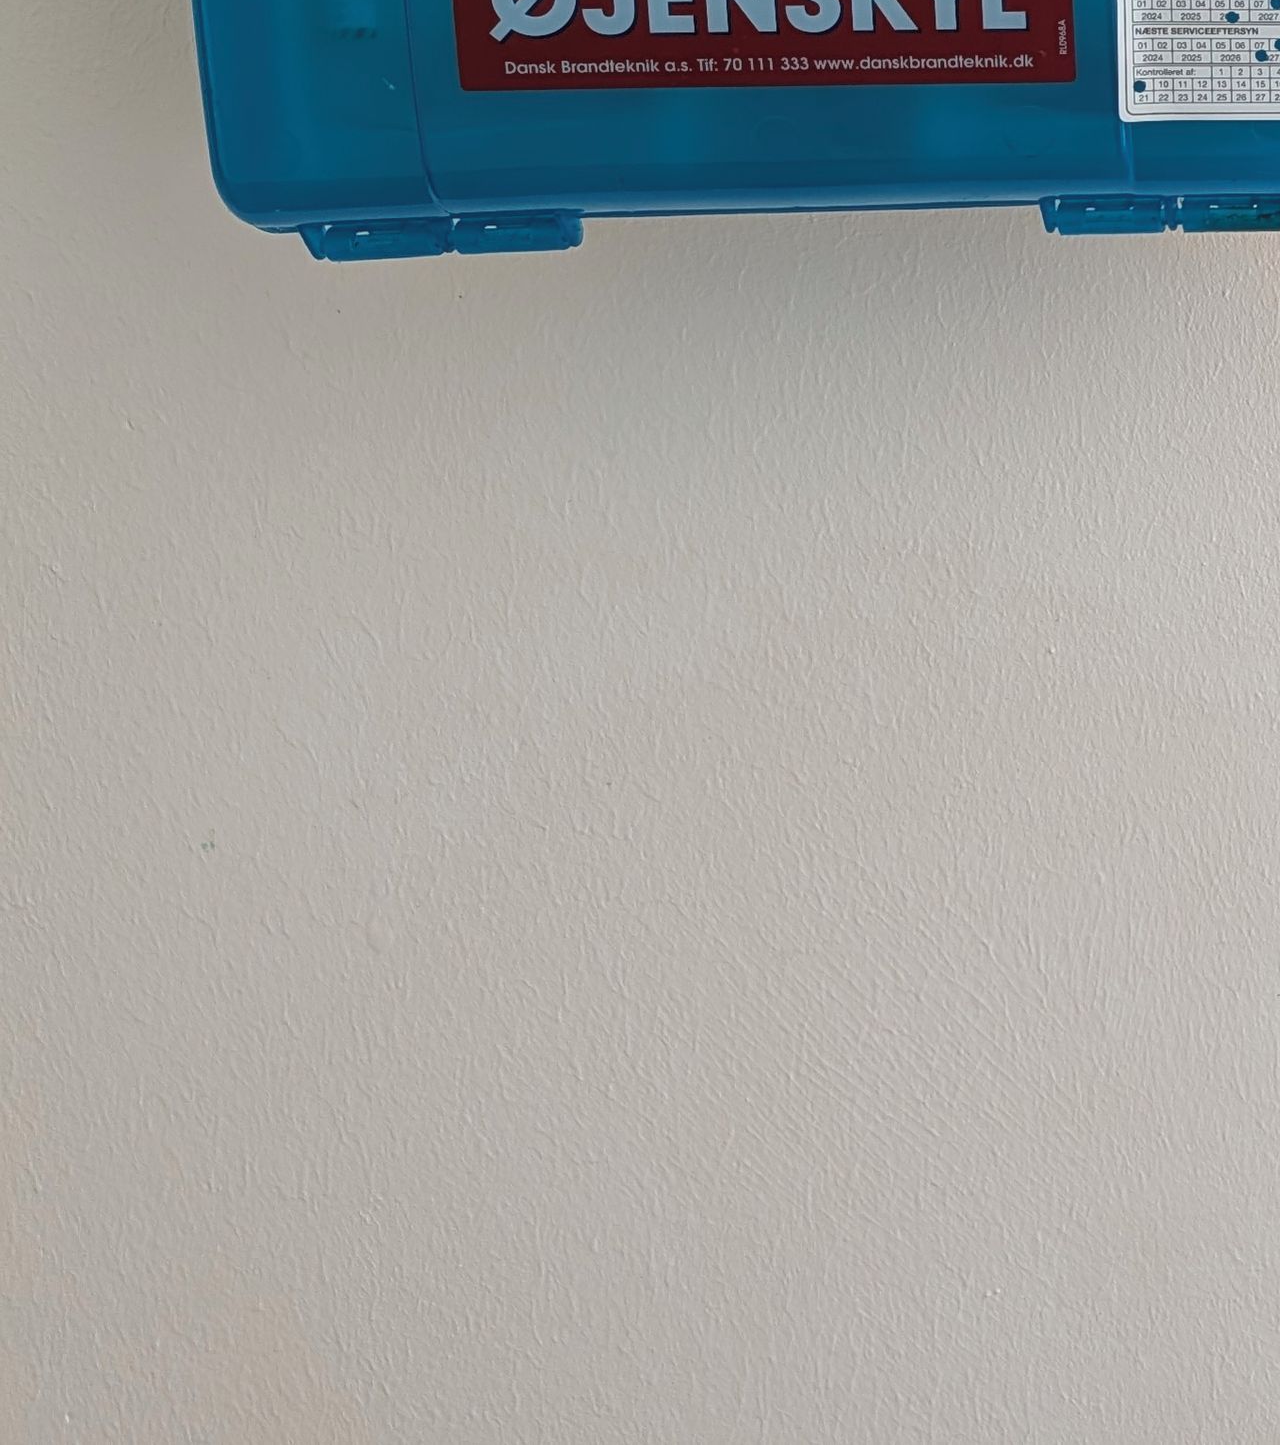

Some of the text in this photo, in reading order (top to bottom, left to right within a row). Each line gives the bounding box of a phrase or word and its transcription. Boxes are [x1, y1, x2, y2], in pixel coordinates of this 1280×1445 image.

[1137, 0, 1146, 9] 01
[1156, 0, 1167, 9] 02
[1175, 0, 1187, 9] 03
[1195, 0, 1206, 9] 04
[1214, 0, 1226, 9] 05
[1234, 0, 1245, 9] 06
[1253, 0, 1264, 9] 07
[1141, 12, 1162, 21] 2024
[1180, 12, 1202, 21] 2025
[1258, 12, 1279, 21] 2027
[1135, 27, 1259, 36] NÆSTE SERVICEEFTERSYN
[1137, 41, 1148, 50] 01
[1156, 41, 1168, 50] 02
[1176, 41, 1187, 50] 03
[1196, 41, 1207, 50] 04
[1215, 41, 1227, 50] 05
[1234, 41, 1246, 50] 06
[1254, 41, 1265, 50] 07
[1142, 54, 1164, 62] 2024
[1181, 54, 1203, 62] 2025
[1220, 54, 1241, 62] 2026
[504, 60, 557, 75] Dansk
[561, 58, 660, 74] Brandteknik
[664, 59, 693, 72] a.s.
[722, 58, 743, 72] 70
[747, 57, 774, 71] 111
[780, 56, 809, 70] 333
[814, 54, 1034, 70] www.danskbrandteknik.dk
[1135, 67, 1197, 76] Kontrolleret af:
[1159, 80, 1169, 88] 10
[1178, 80, 1188, 88] 11
[1198, 80, 1208, 88] 12
[1217, 80, 1227, 88] 13
[1236, 80, 1247, 88] 14
[1255, 80, 1266, 88] 15
[1138, 93, 1149, 102] 21
[1158, 93, 1169, 102] 22
[1177, 93, 1189, 102] 23
[1197, 93, 1208, 102] 24
[1216, 93, 1228, 102] 25
[1235, 93, 1247, 102] 26
[1255, 93, 1266, 102] 27
